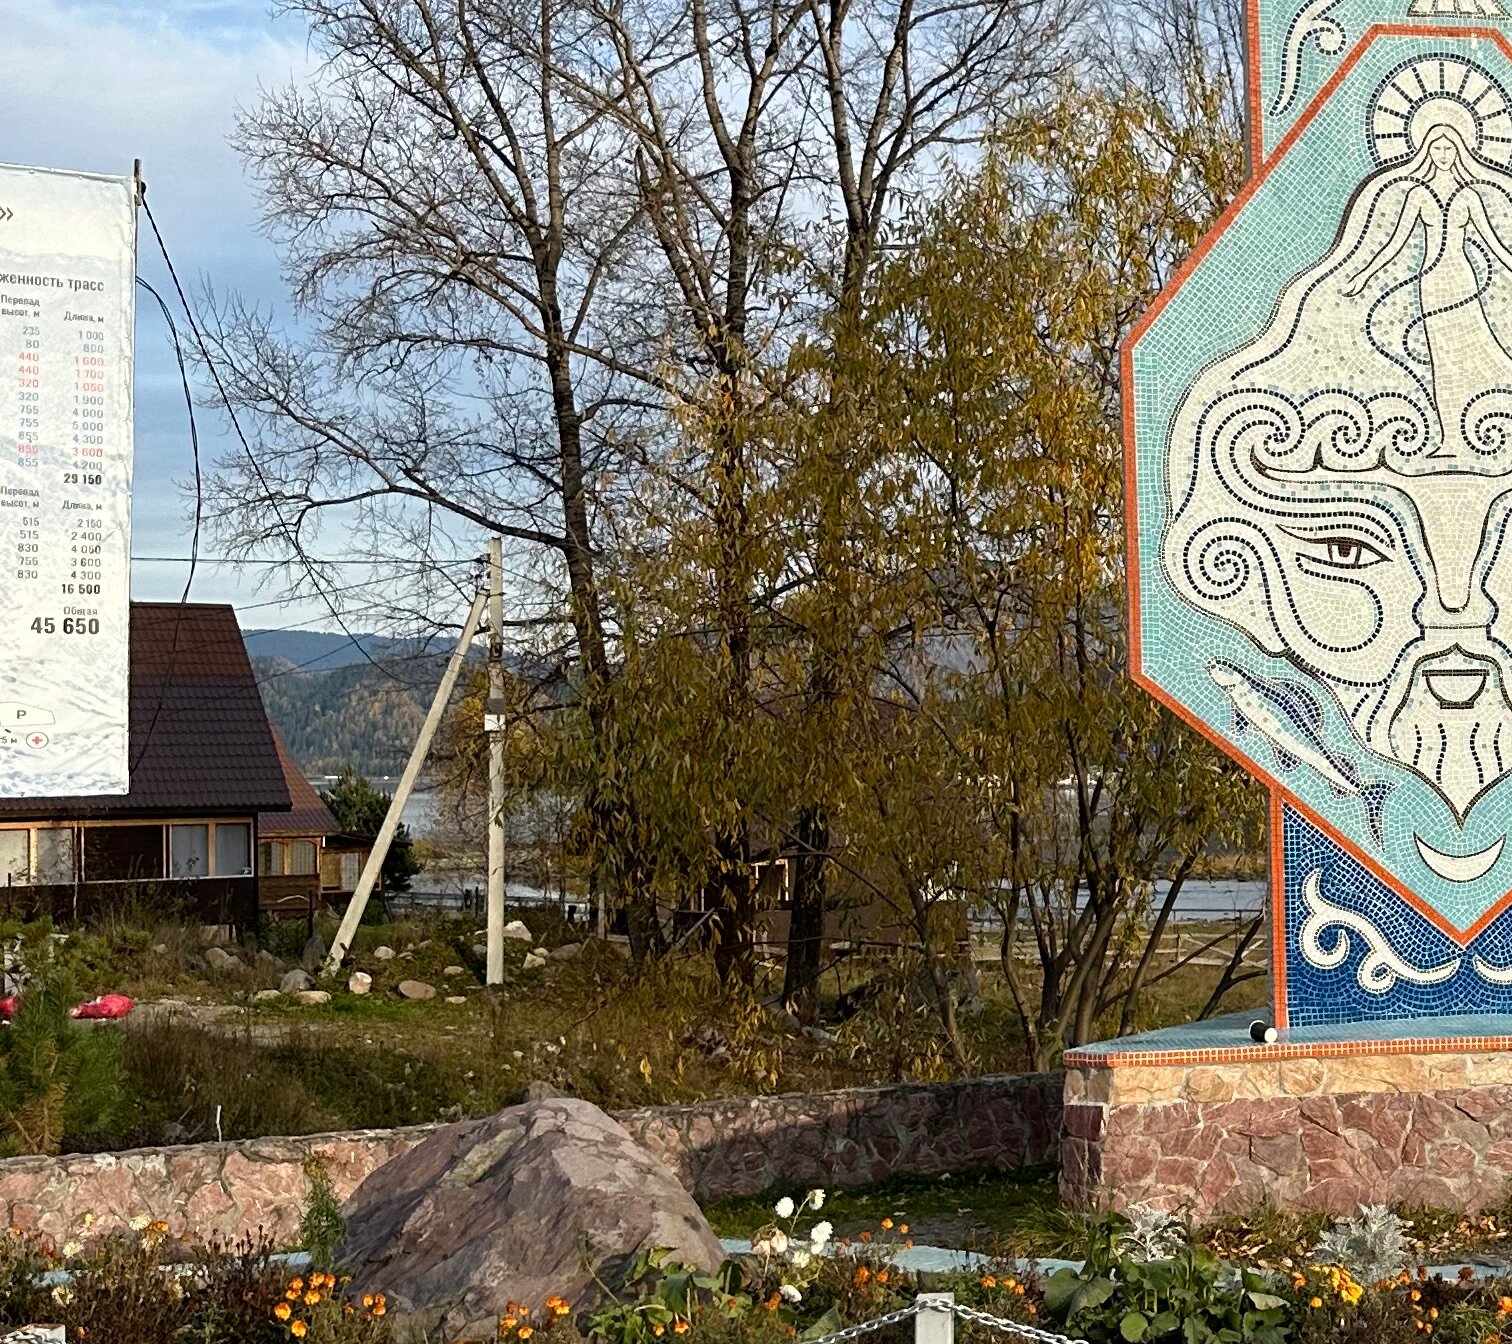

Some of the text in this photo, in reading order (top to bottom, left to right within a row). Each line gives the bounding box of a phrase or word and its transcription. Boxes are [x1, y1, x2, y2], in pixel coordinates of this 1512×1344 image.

[68, 278, 104, 292] трасс
[25, 339, 40, 349] 80
[18, 392, 39, 402] 320
[20, 405, 39, 415] 755
[20, 418, 39, 428] 755
[20, 529, 39, 540] 515
[18, 543, 39, 553] 830
[17, 569, 38, 579] 830
[63, 606, 98, 616] Общая
